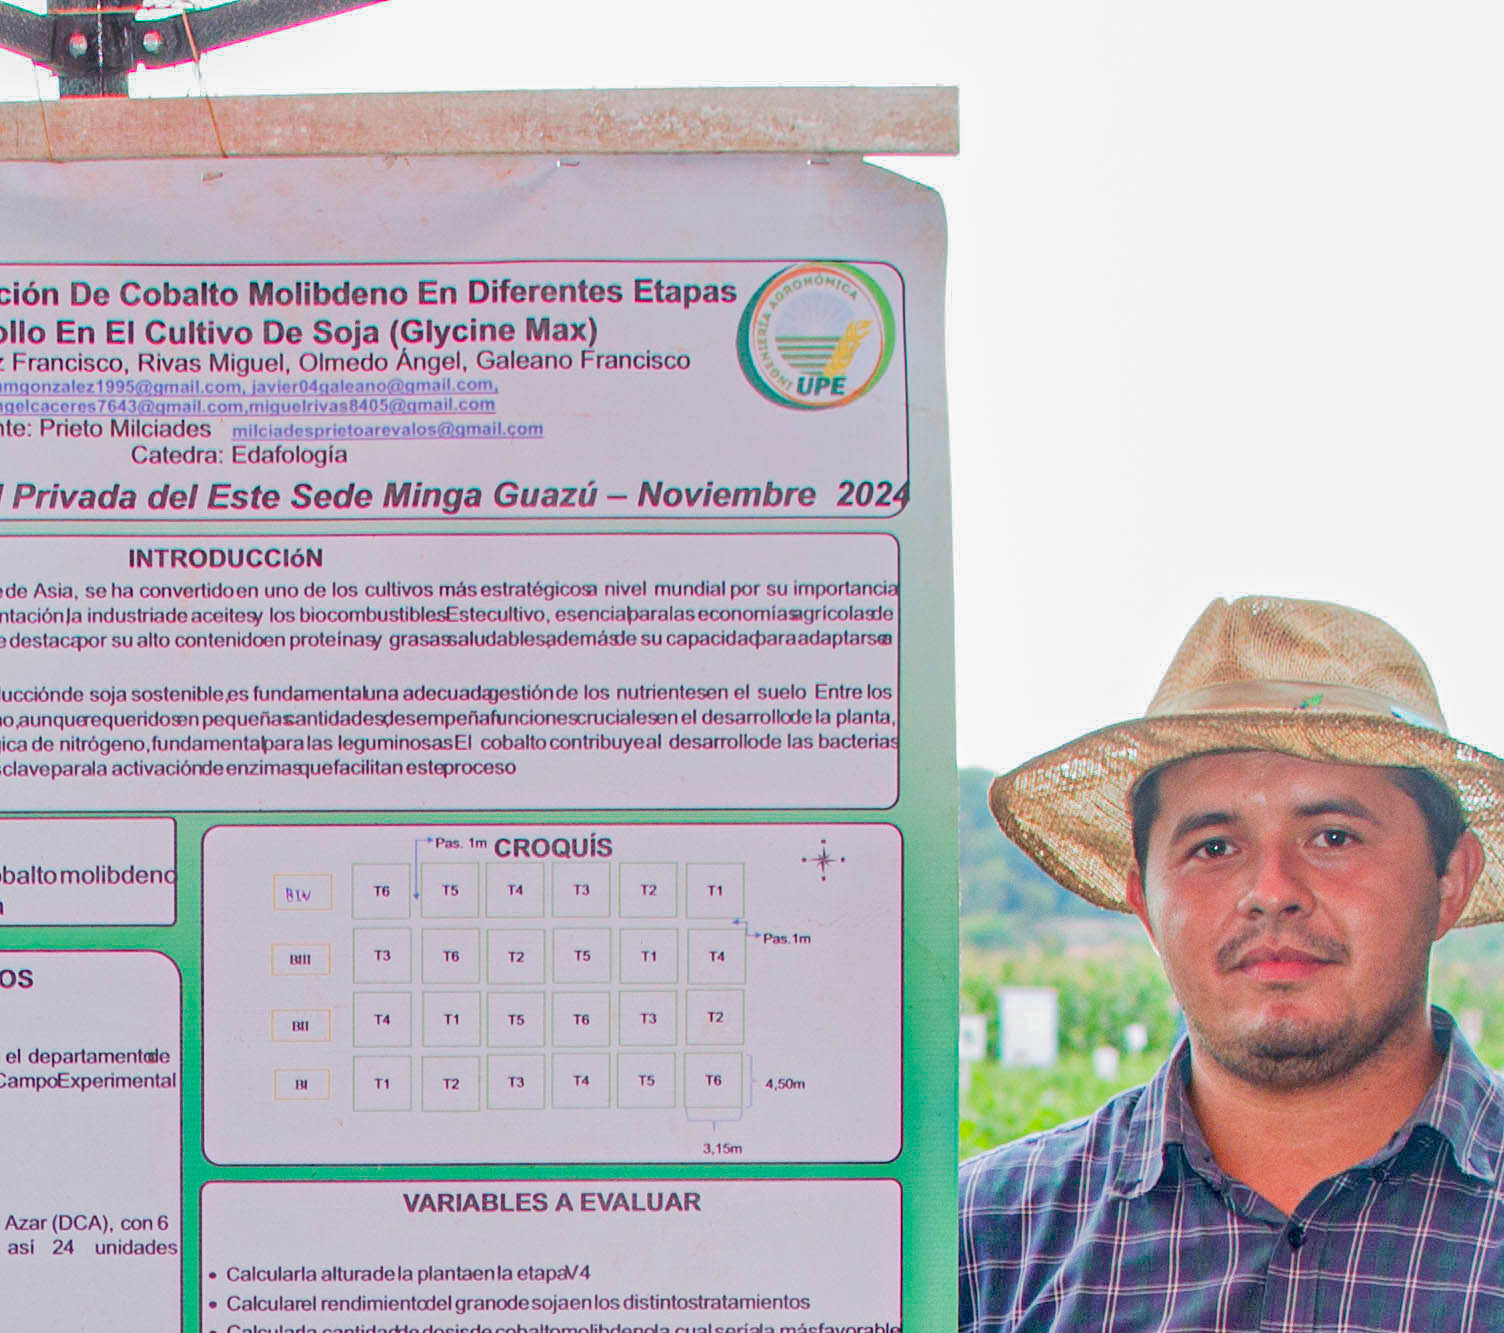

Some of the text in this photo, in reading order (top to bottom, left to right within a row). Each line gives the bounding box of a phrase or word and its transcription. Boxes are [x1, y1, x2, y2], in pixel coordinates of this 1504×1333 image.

[71, 282, 110, 306] De
[120, 282, 238, 306] Cobalto
[250, 280, 408, 306] Molibdeno
[419, 280, 456, 305] En
[469, 279, 623, 303] Diferentes
[635, 279, 737, 309] Etapas
[57, 320, 94, 344] En
[107, 320, 134, 344] El
[145, 320, 252, 345] Cultivo
[264, 320, 302, 344] De
[313, 320, 379, 350] Soja
[391, 317, 516, 347] (Glycine
[526, 317, 597, 348] Max)
[13, 352, 128, 375] Francisco,
[139, 353, 197, 372] Rivas
[210, 353, 290, 377] Miguel,
[299, 352, 388, 372] Olmedo
[396, 347, 467, 376] Ángel,
[477, 350, 572, 369] Galeano
[581, 350, 690, 369] Francisco
[797, 376, 847, 395] UPE
[40, 418, 102, 437] Prieto
[111, 419, 211, 438] Milciades
[132, 445, 347, 468] Catedra: Edafología
[13, 483, 136, 509] Privada
[148, 484, 198, 509] del
[208, 484, 280, 509] Este
[291, 482, 375, 510] Sede
[382, 482, 482, 513] Minga
[492, 480, 599, 510] Guazú
[637, 480, 817, 510] Noviembre
[837, 479, 910, 509] 2024
[34, 583, 78, 600] Asia,
[265, 586, 298, 598] uno
[304, 582, 326, 598] de
[333, 582, 358, 597] los
[365, 581, 433, 597] cultivos
[440, 581, 477, 597] más
[605, 580, 647, 598] nivel
[655, 581, 725, 596] mundial
[731, 584, 760, 600] por
[767, 584, 788, 598] su
[793, 579, 898, 598] importancia
[435, 837, 487, 850] Pas. 1m
[495, 833, 612, 858] CROQUÍS
[374, 886, 390, 897] T6
[442, 885, 458, 896] T5
[508, 885, 523, 895] T4
[574, 884, 589, 895] T3
[641, 884, 657, 896] T2
[708, 885, 722, 896] T1
[766, 1078, 805, 1091] 4,50m
[703, 1143, 742, 1155] 3,15m
[403, 1192, 701, 1212] VARIABLES A EVALUAR
